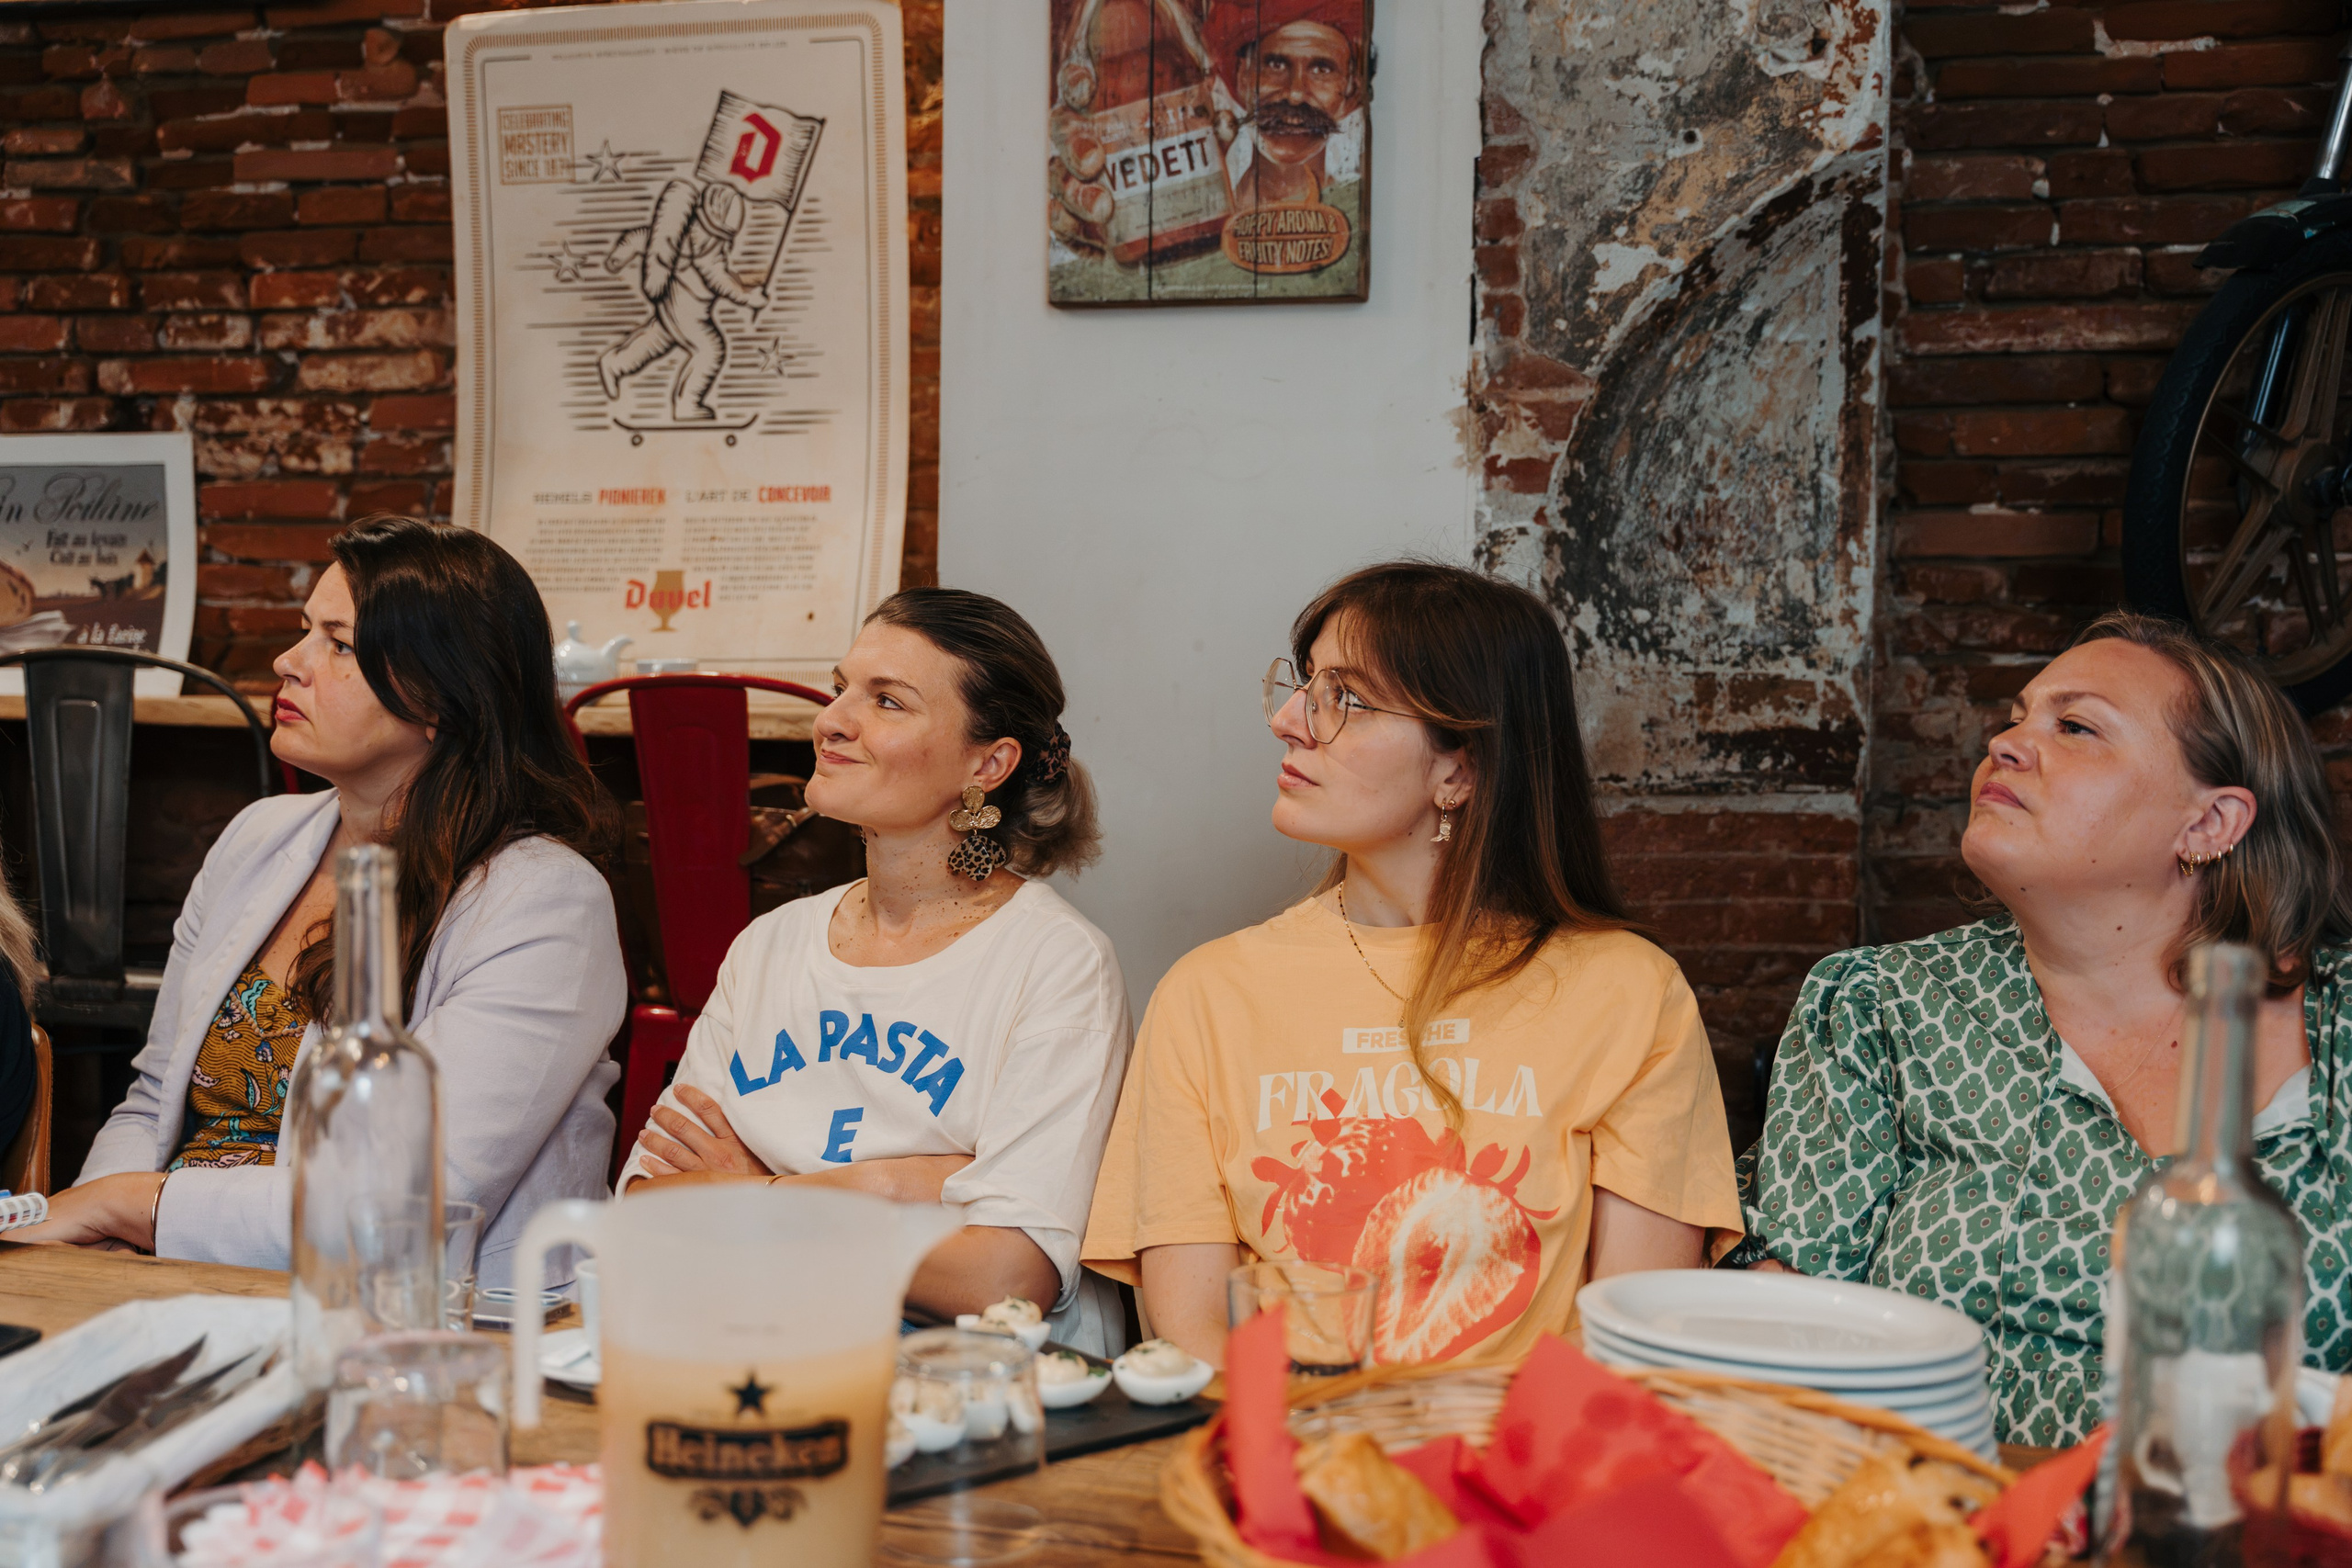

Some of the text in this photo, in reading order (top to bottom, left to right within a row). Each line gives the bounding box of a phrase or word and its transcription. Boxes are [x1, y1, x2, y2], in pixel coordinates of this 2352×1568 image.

[504, 131, 569, 156] MASTERY
[1102, 137, 1208, 192] VEDETT
[1276, 209, 1326, 234] AROMA
[1238, 238, 1332, 266] FRUITY NOTES
[626, 580, 711, 609] Duvel
[1357, 1022, 1454, 1049] FRESHE
[729, 1010, 965, 1117] LA PASTA
[1256, 1057, 1544, 1133] FRAGOLA
[820, 1107, 864, 1163] E
